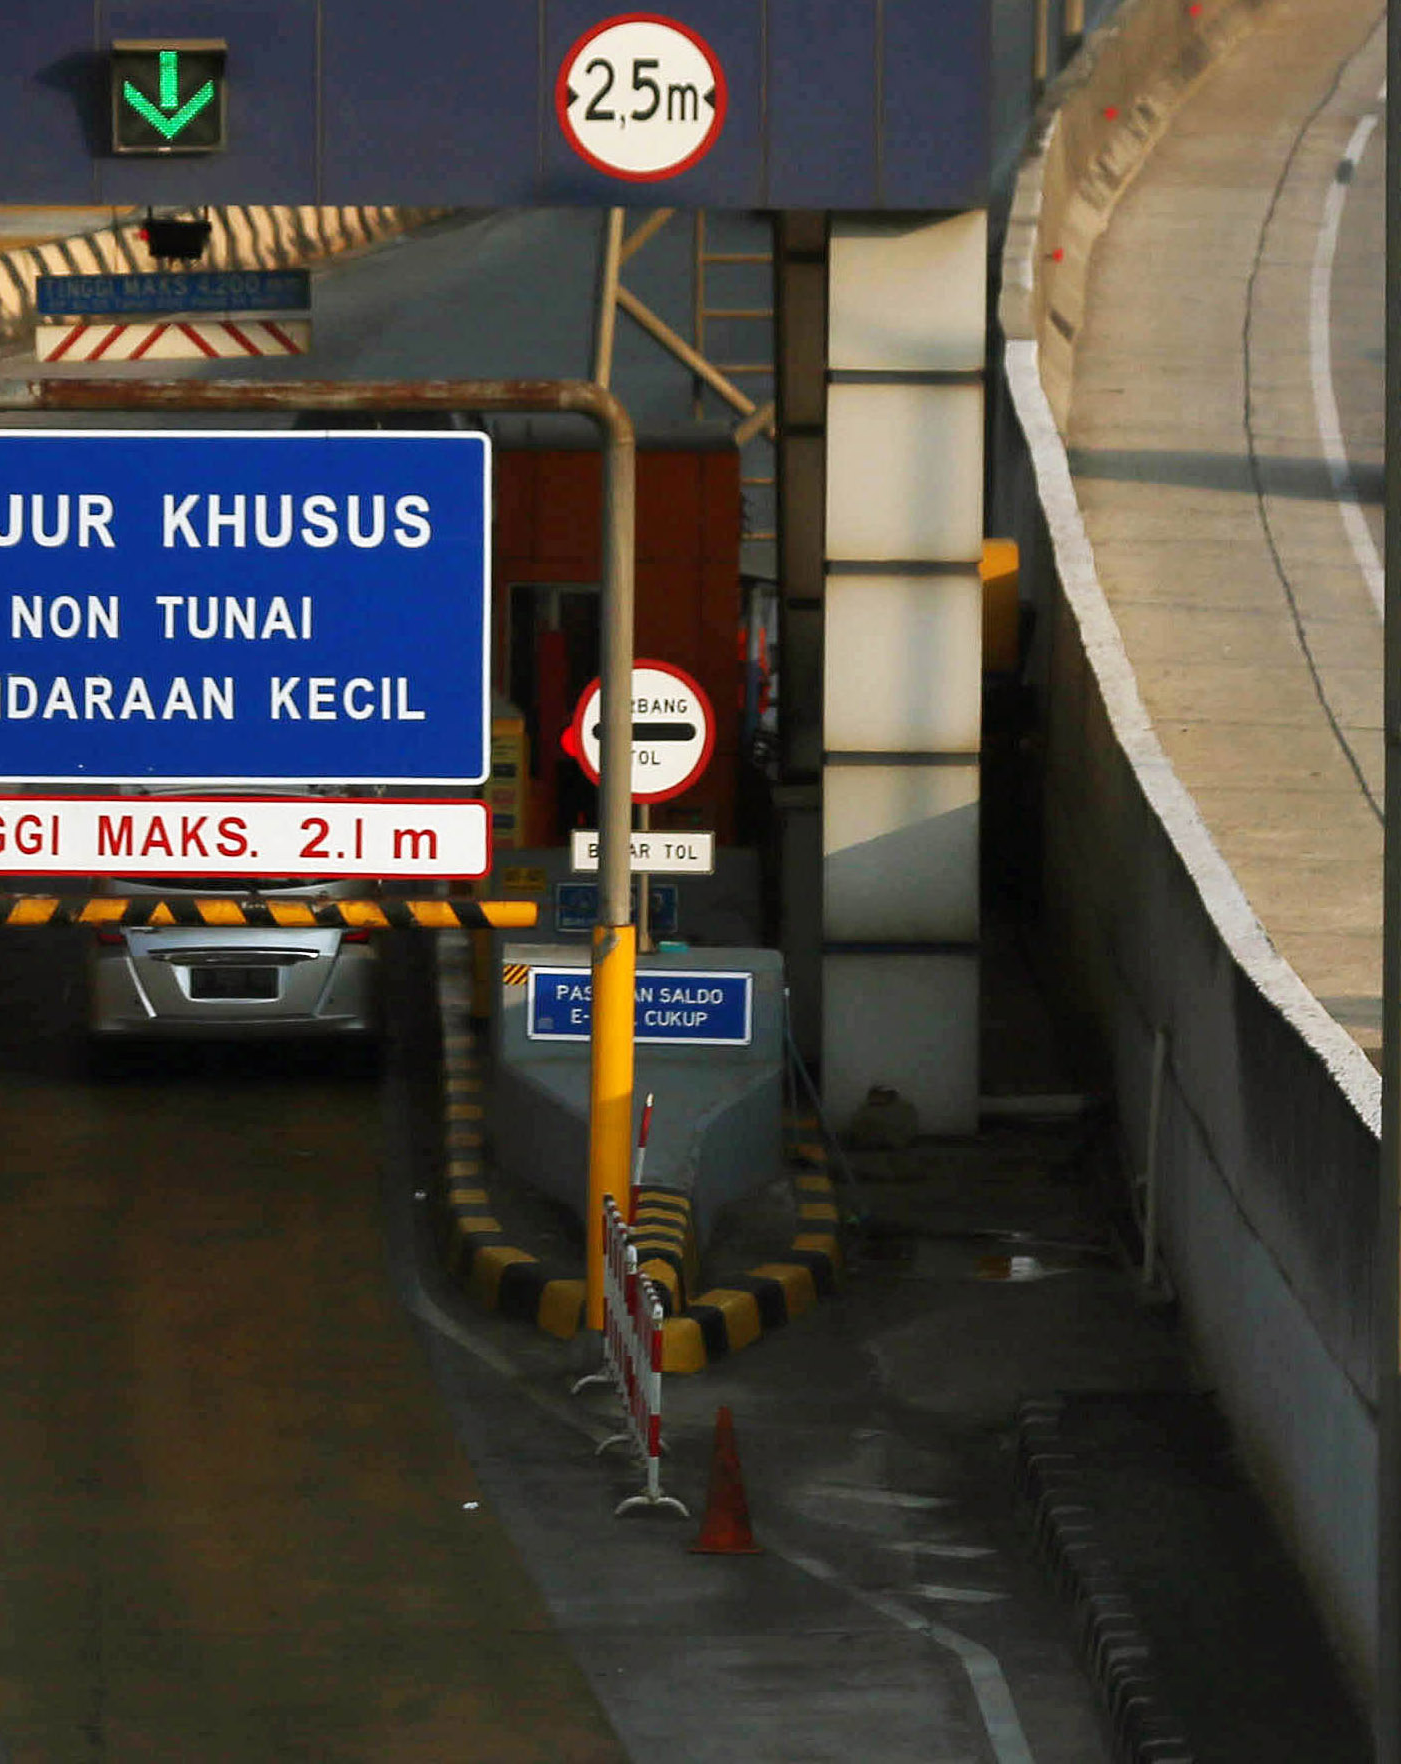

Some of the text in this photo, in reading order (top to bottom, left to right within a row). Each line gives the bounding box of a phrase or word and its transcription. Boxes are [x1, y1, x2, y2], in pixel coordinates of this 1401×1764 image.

[585, 58, 698, 129] 2,5m
[163, 494, 432, 548] KHUSUS
[12, 595, 312, 640] NON TUNAI
[271, 676, 426, 720] KECIL
[97, 815, 258, 857] MAKS.
[393, 829, 437, 860] m
[665, 844, 697, 859] TOL
[659, 988, 724, 1004] SALDO
[645, 1010, 708, 1027] CUKUP
